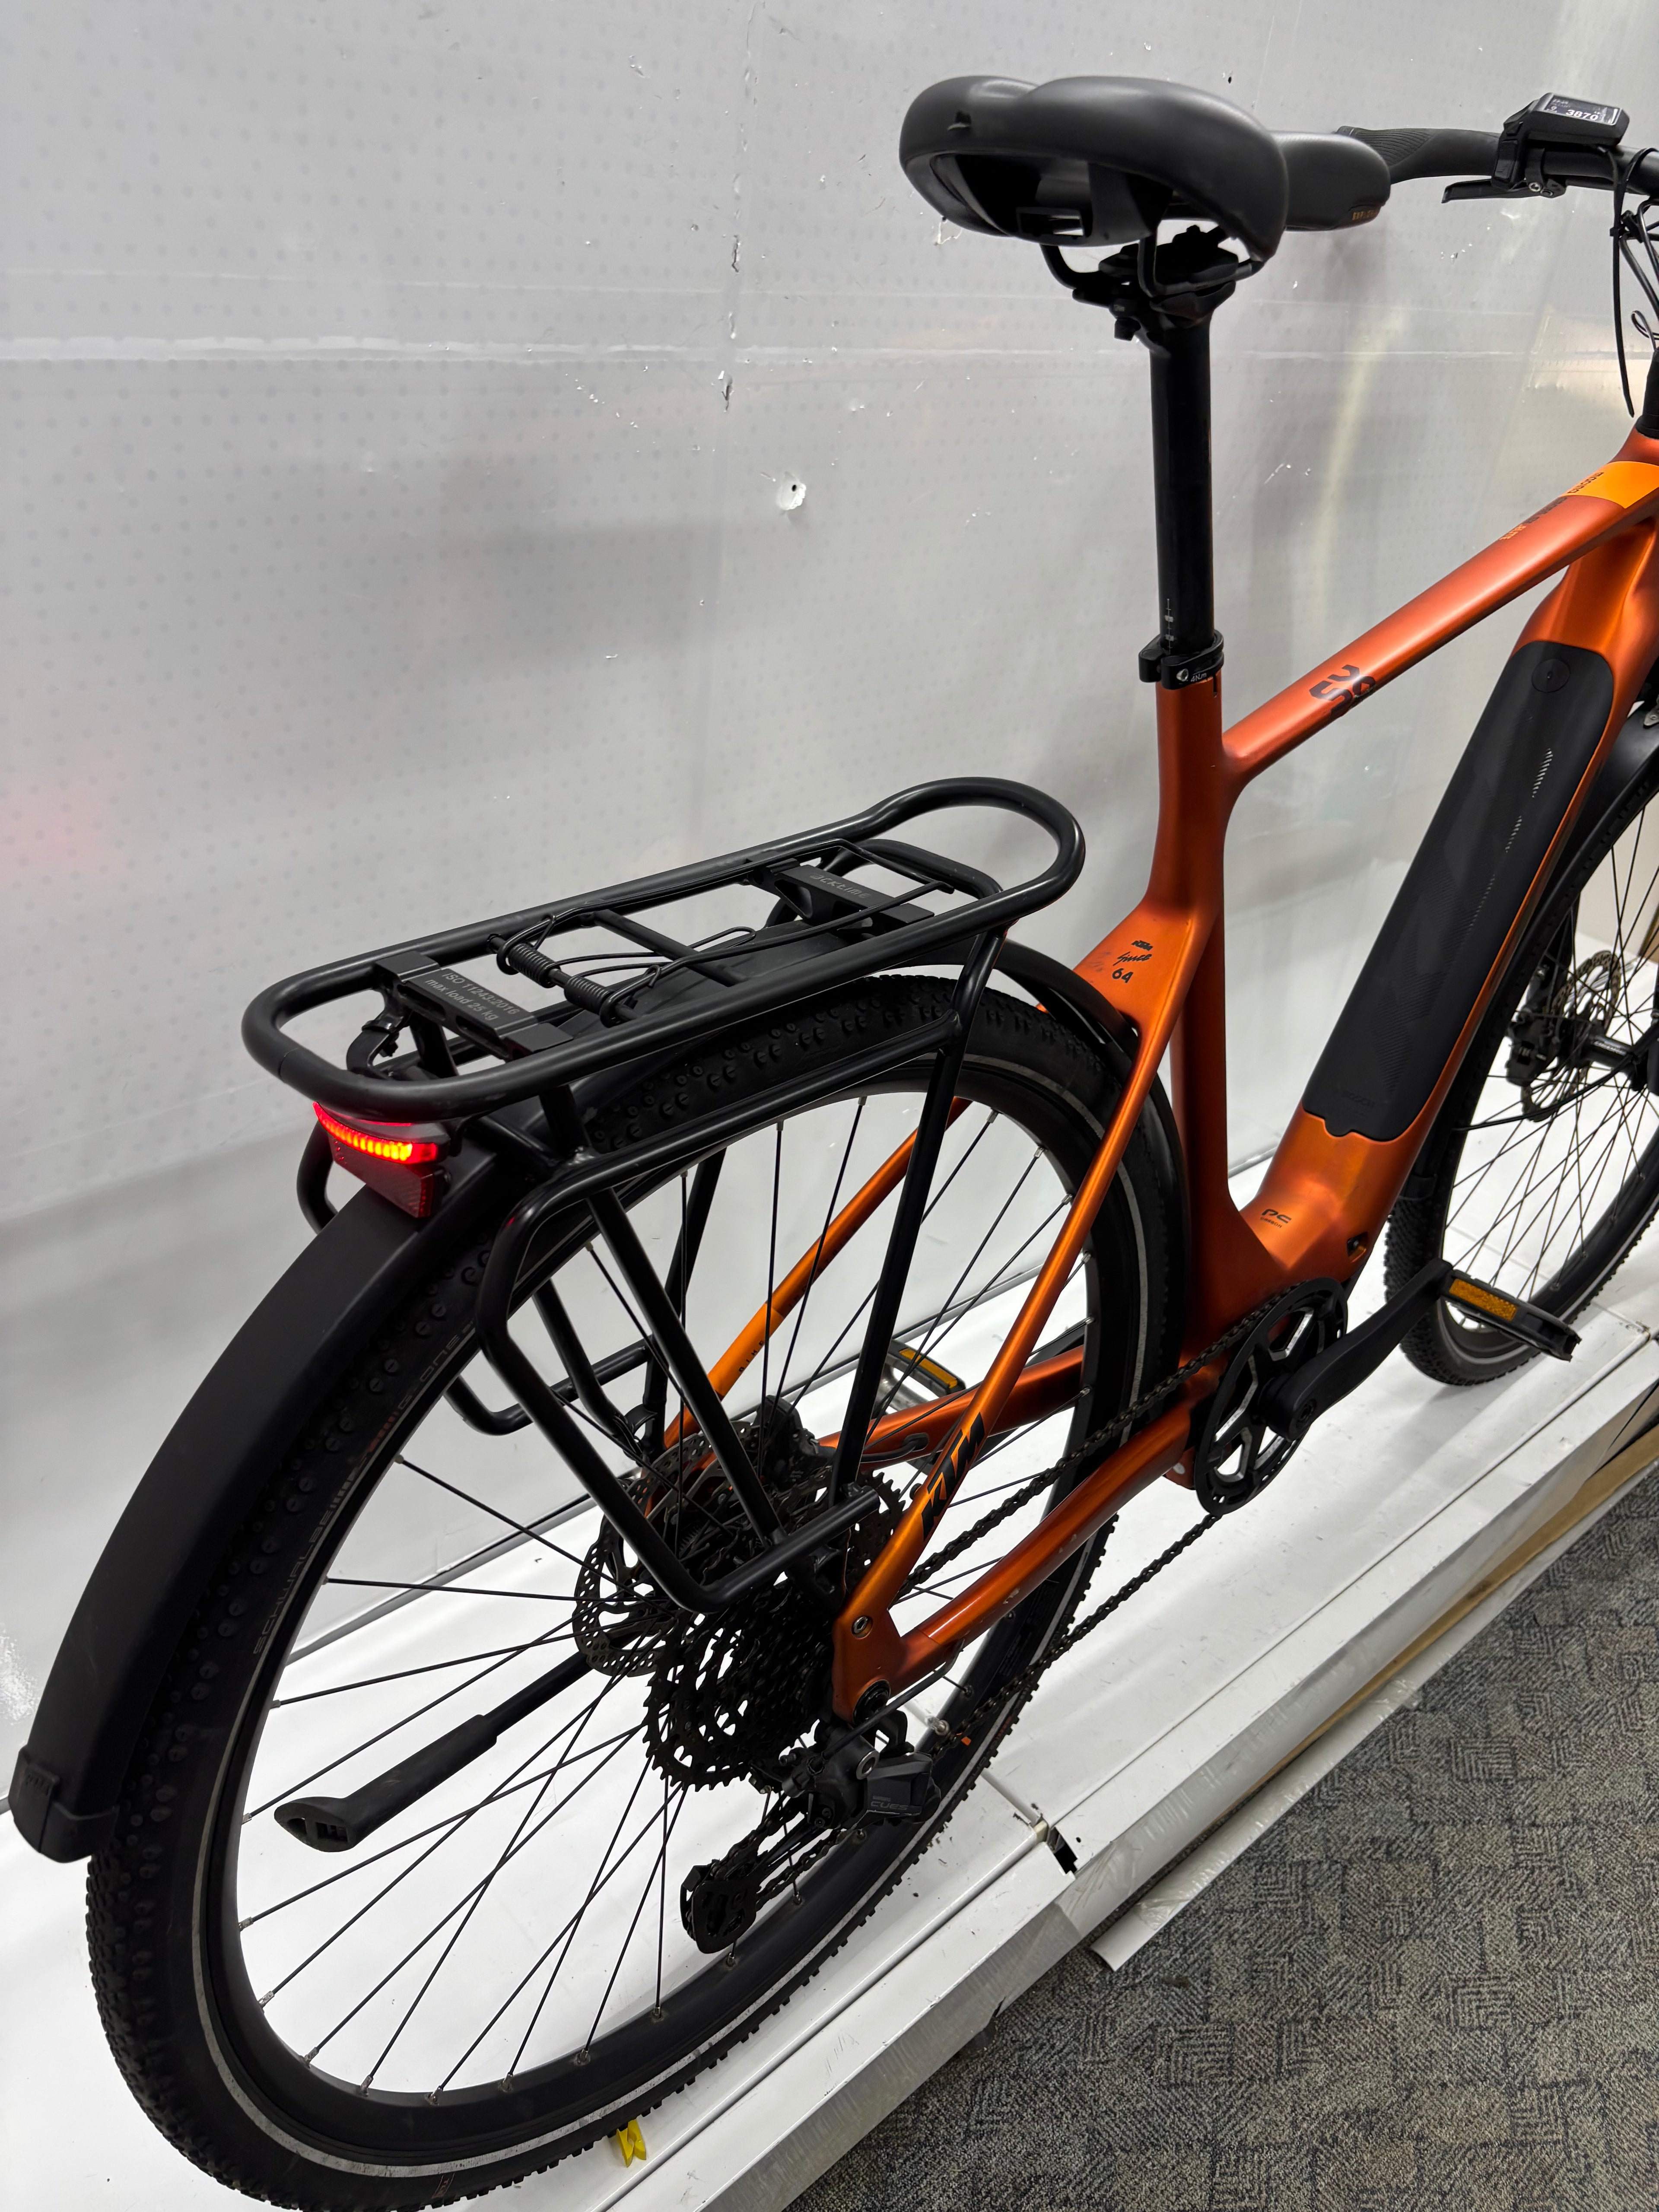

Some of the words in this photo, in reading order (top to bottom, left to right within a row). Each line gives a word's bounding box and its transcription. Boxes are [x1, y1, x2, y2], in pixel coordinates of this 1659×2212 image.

[1566, 109, 1599, 121] 3870
[1112, 968, 1134, 983] 64
[425, 979, 448, 992] max
[445, 990, 474, 1004] load
[467, 1002, 486, 1012] 25
[482, 1010, 499, 1021] kg
[441, 973, 465, 984] ISO
[461, 983, 520, 1014] 11243:2016
[253, 1509, 334, 1654] SCHWALBE
[870, 1801, 909, 1811] CUES
